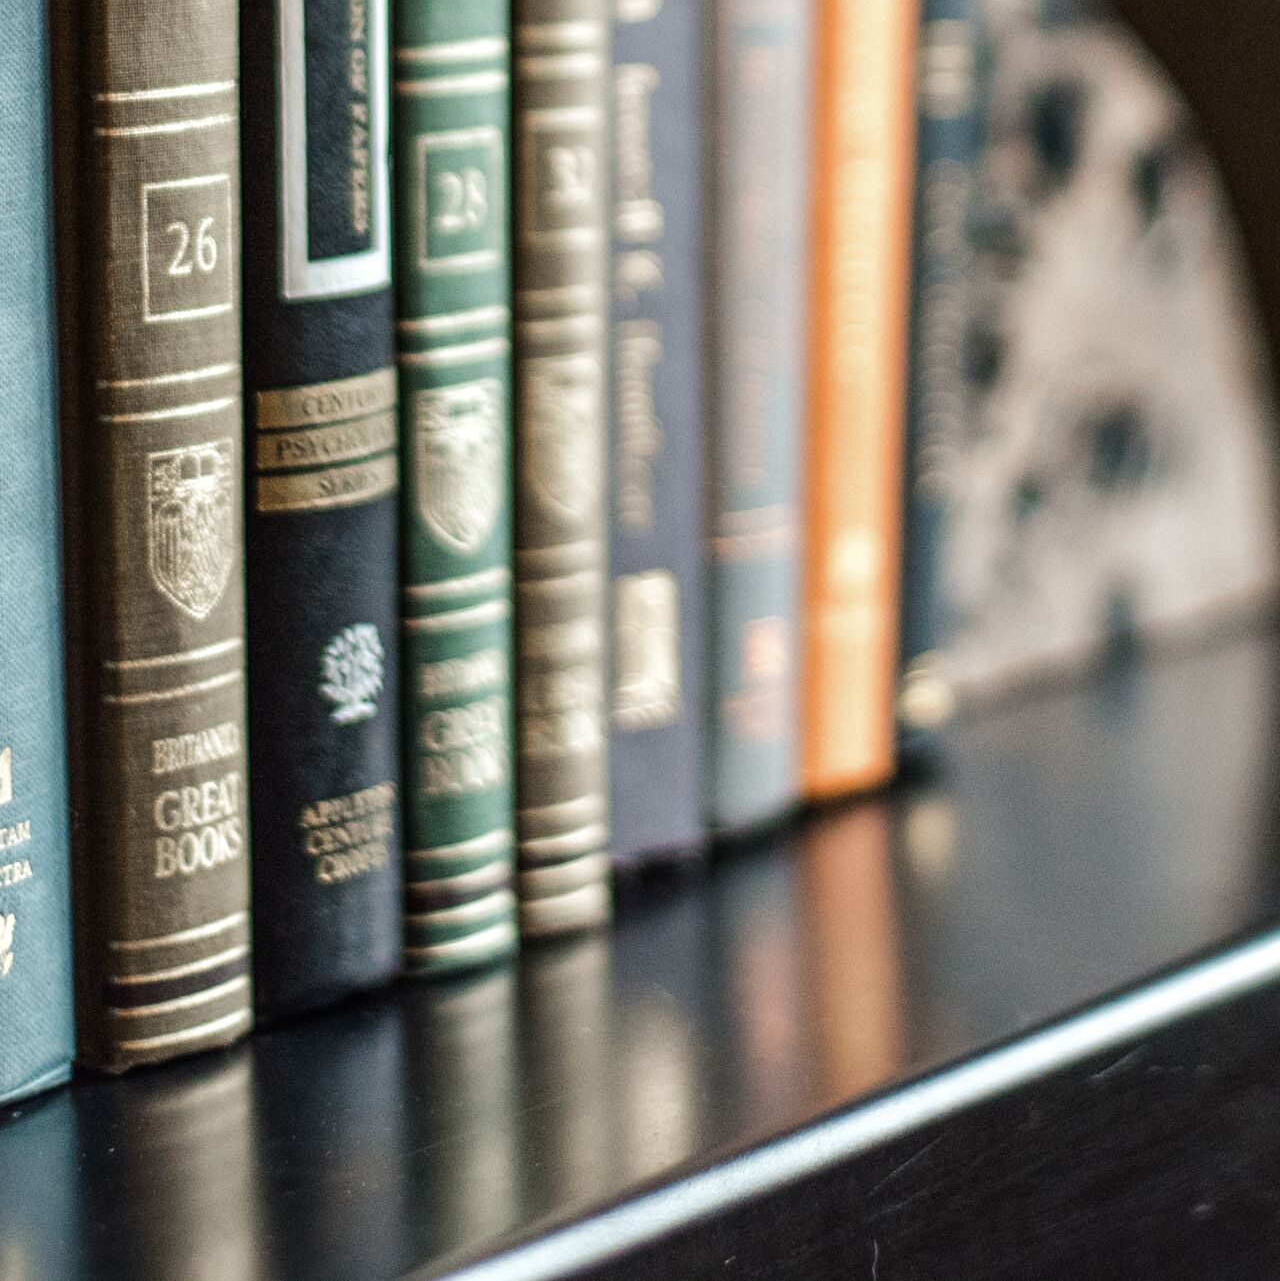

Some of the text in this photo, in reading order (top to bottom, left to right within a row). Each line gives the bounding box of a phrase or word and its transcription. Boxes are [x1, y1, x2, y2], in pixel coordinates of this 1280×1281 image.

[167, 217, 218, 275] 26
[155, 772, 241, 831] GREAT
[155, 818, 242, 878] BOOKS
